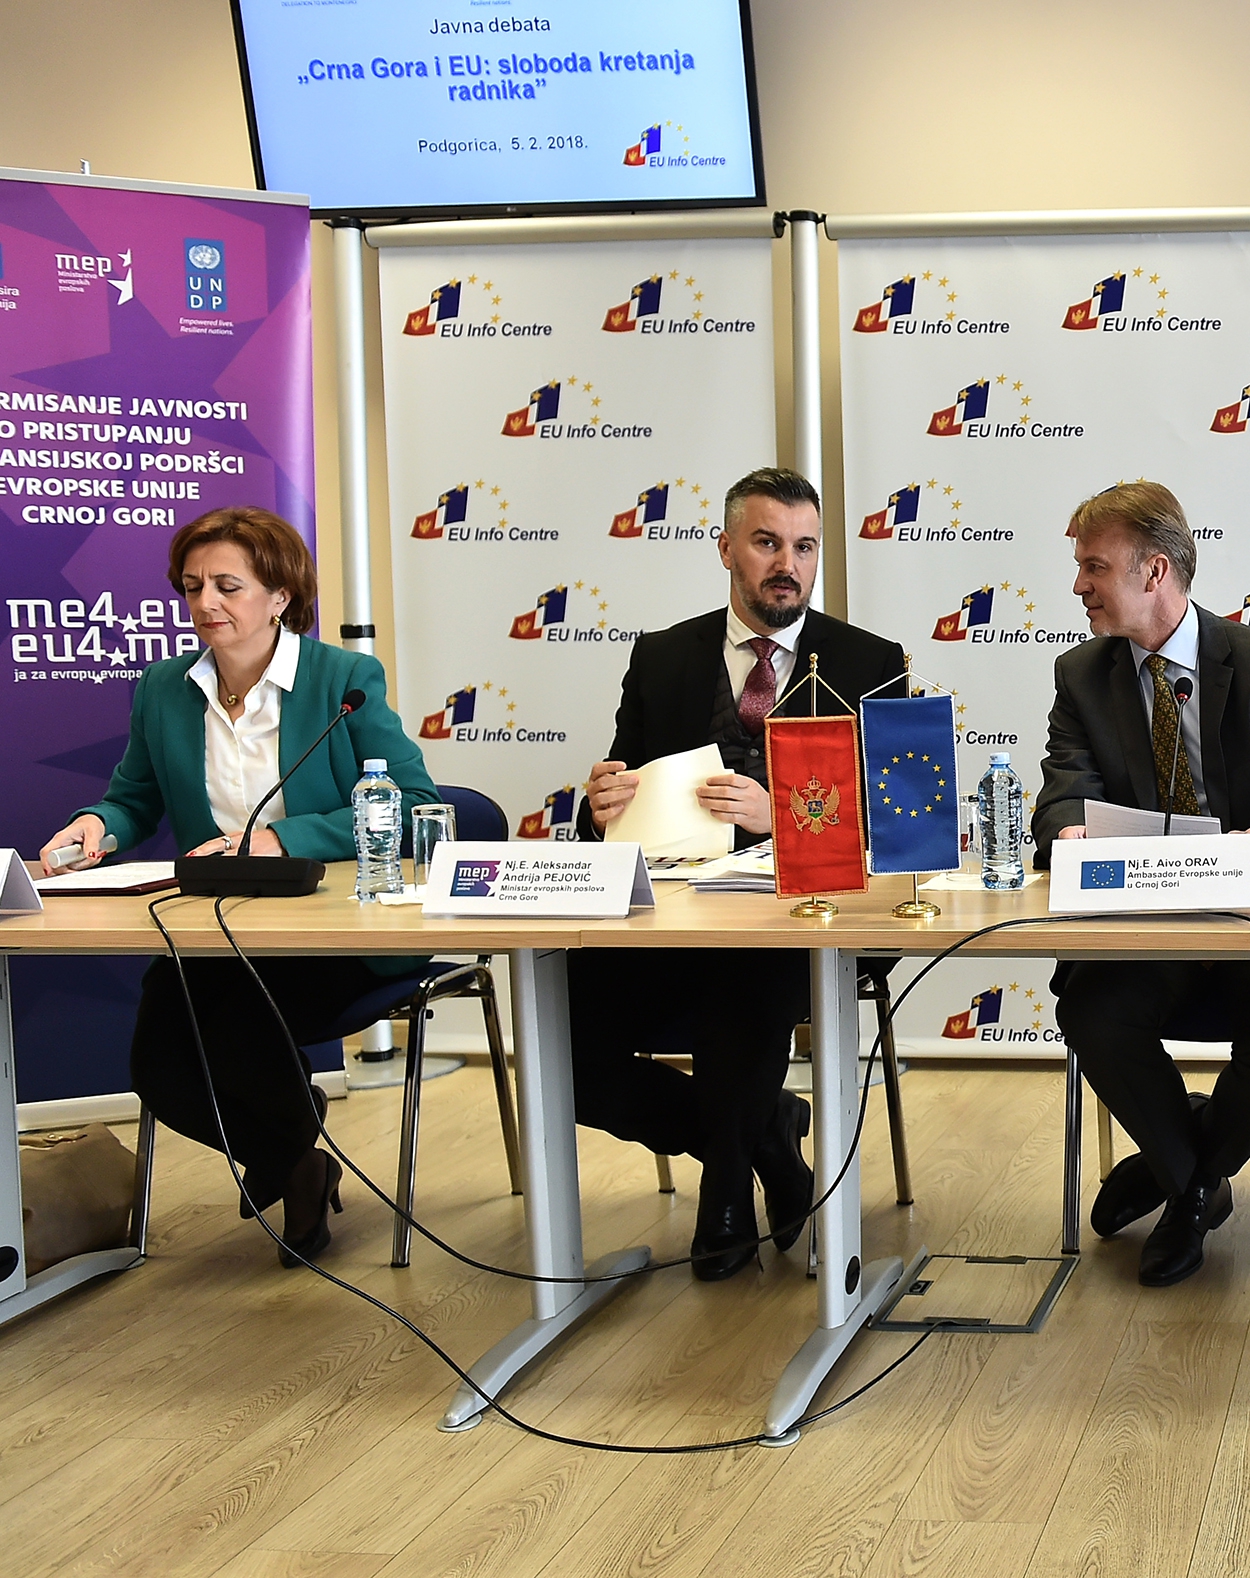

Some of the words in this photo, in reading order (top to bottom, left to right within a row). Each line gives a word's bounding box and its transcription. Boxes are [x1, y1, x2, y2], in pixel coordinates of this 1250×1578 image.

[430, 18, 484, 35] Javna
[488, 16, 551, 33] debata
[371, 57, 427, 79] Gora
[435, 56, 442, 76] i
[448, 55, 490, 77] EU:
[499, 52, 592, 75] sloboda
[600, 49, 695, 75] kretanja
[418, 137, 501, 155] Podgorica,
[511, 137, 526, 151] 5.
[529, 137, 543, 151] 2.
[547, 135, 589, 150] 2018.
[649, 156, 665, 168] EU
[667, 155, 688, 167] Info
[691, 155, 726, 166] Centre
[54, 253, 112, 277] mep
[441, 324, 463, 337] EU
[468, 323, 496, 337] Info
[502, 323, 552, 336] Centre
[641, 320, 664, 334] EU
[669, 319, 698, 333] Info
[704, 319, 755, 333] Centre
[893, 321, 917, 334] EU
[921, 320, 951, 334] Info
[957, 320, 1009, 334] Centre
[1103, 317, 1127, 331] EU
[1131, 317, 1162, 331] Info
[1168, 317, 1221, 331] Centre
[129, 398, 247, 420] JAVNOSTI
[0, 420, 16, 438] O
[23, 421, 191, 445] PRISTUPANJU
[0, 449, 132, 471] ANSIJSKOJ
[140, 451, 244, 474] PODRŠCI
[0, 476, 124, 498] EVROPSKE
[132, 481, 200, 500] UNIJE
[22, 505, 106, 525] CRNOJ
[113, 507, 175, 526] GORI
[648, 526, 671, 540] EU
[675, 525, 704, 540] Info
[547, 628, 569, 641] EU
[573, 628, 603, 641] Info
[972, 630, 995, 643] EU
[1000, 630, 1029, 643] Info
[1035, 630, 1087, 643] Centre
[14, 669, 27, 682] ja
[31, 670, 47, 680] za
[456, 729, 478, 742] EU
[483, 729, 511, 742] Info
[517, 729, 566, 742] Centre
[966, 731, 1018, 744] Centre
[505, 860, 529, 871] Nj.E.
[532, 860, 592, 870] Aleksandar
[1127, 859, 1153, 870] Nj.E.
[1156, 858, 1182, 868] Aivo
[1185, 857, 1218, 867] ORAV
[458, 866, 490, 881] mep
[502, 873, 541, 883] Andrija
[543, 871, 592, 882] PEJOVIĆ
[1127, 870, 1177, 879] Ambasador
[1179, 869, 1220, 878] Evropske
[1222, 868, 1244, 877] unije
[501, 884, 532, 892] Ministar
[534, 884, 572, 893] evropskih
[573, 885, 605, 893] poslova
[1135, 880, 1159, 890] Crnoj
[1161, 880, 1180, 888] Gori
[498, 893, 518, 901] Crne
[519, 893, 539, 901] Gore
